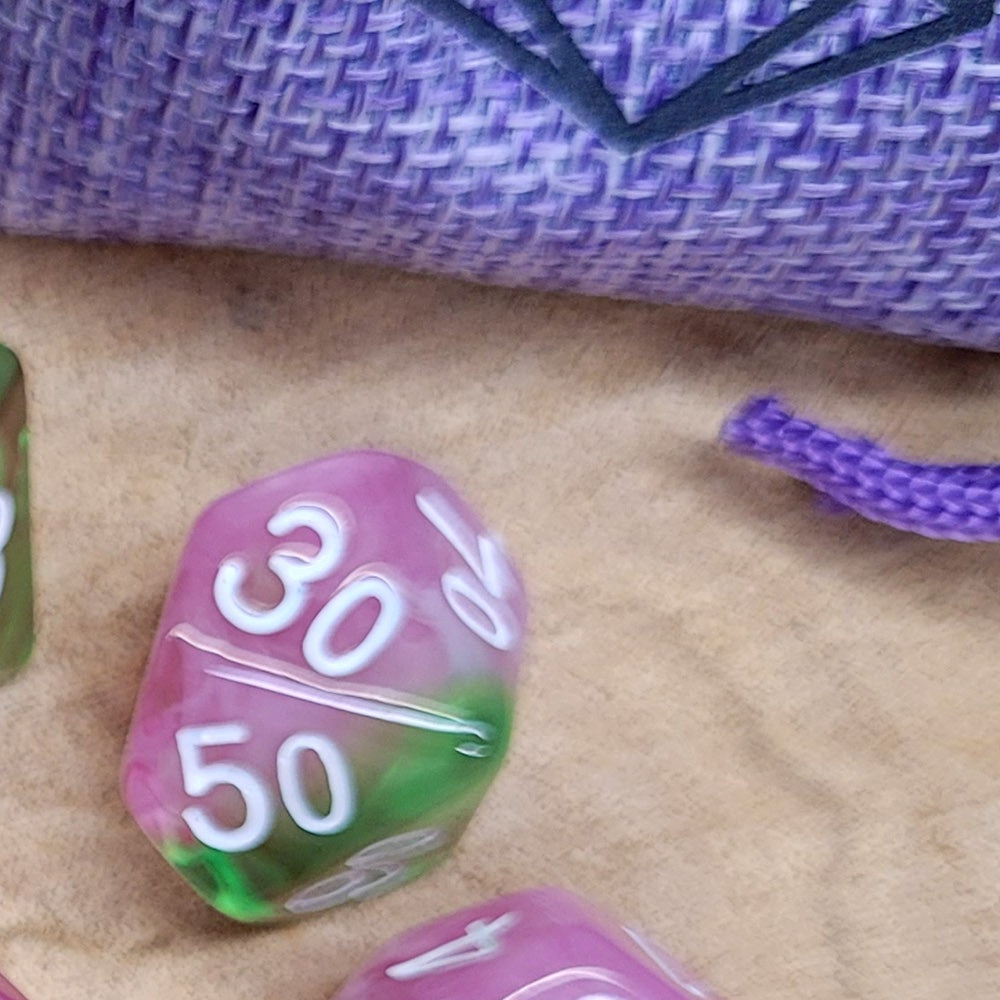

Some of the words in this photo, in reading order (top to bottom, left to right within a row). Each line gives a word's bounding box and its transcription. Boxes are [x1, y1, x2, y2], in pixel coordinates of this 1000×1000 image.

[213, 504, 402, 678] 30
[176, 723, 355, 853] 50
[386, 912, 522, 980] 4
